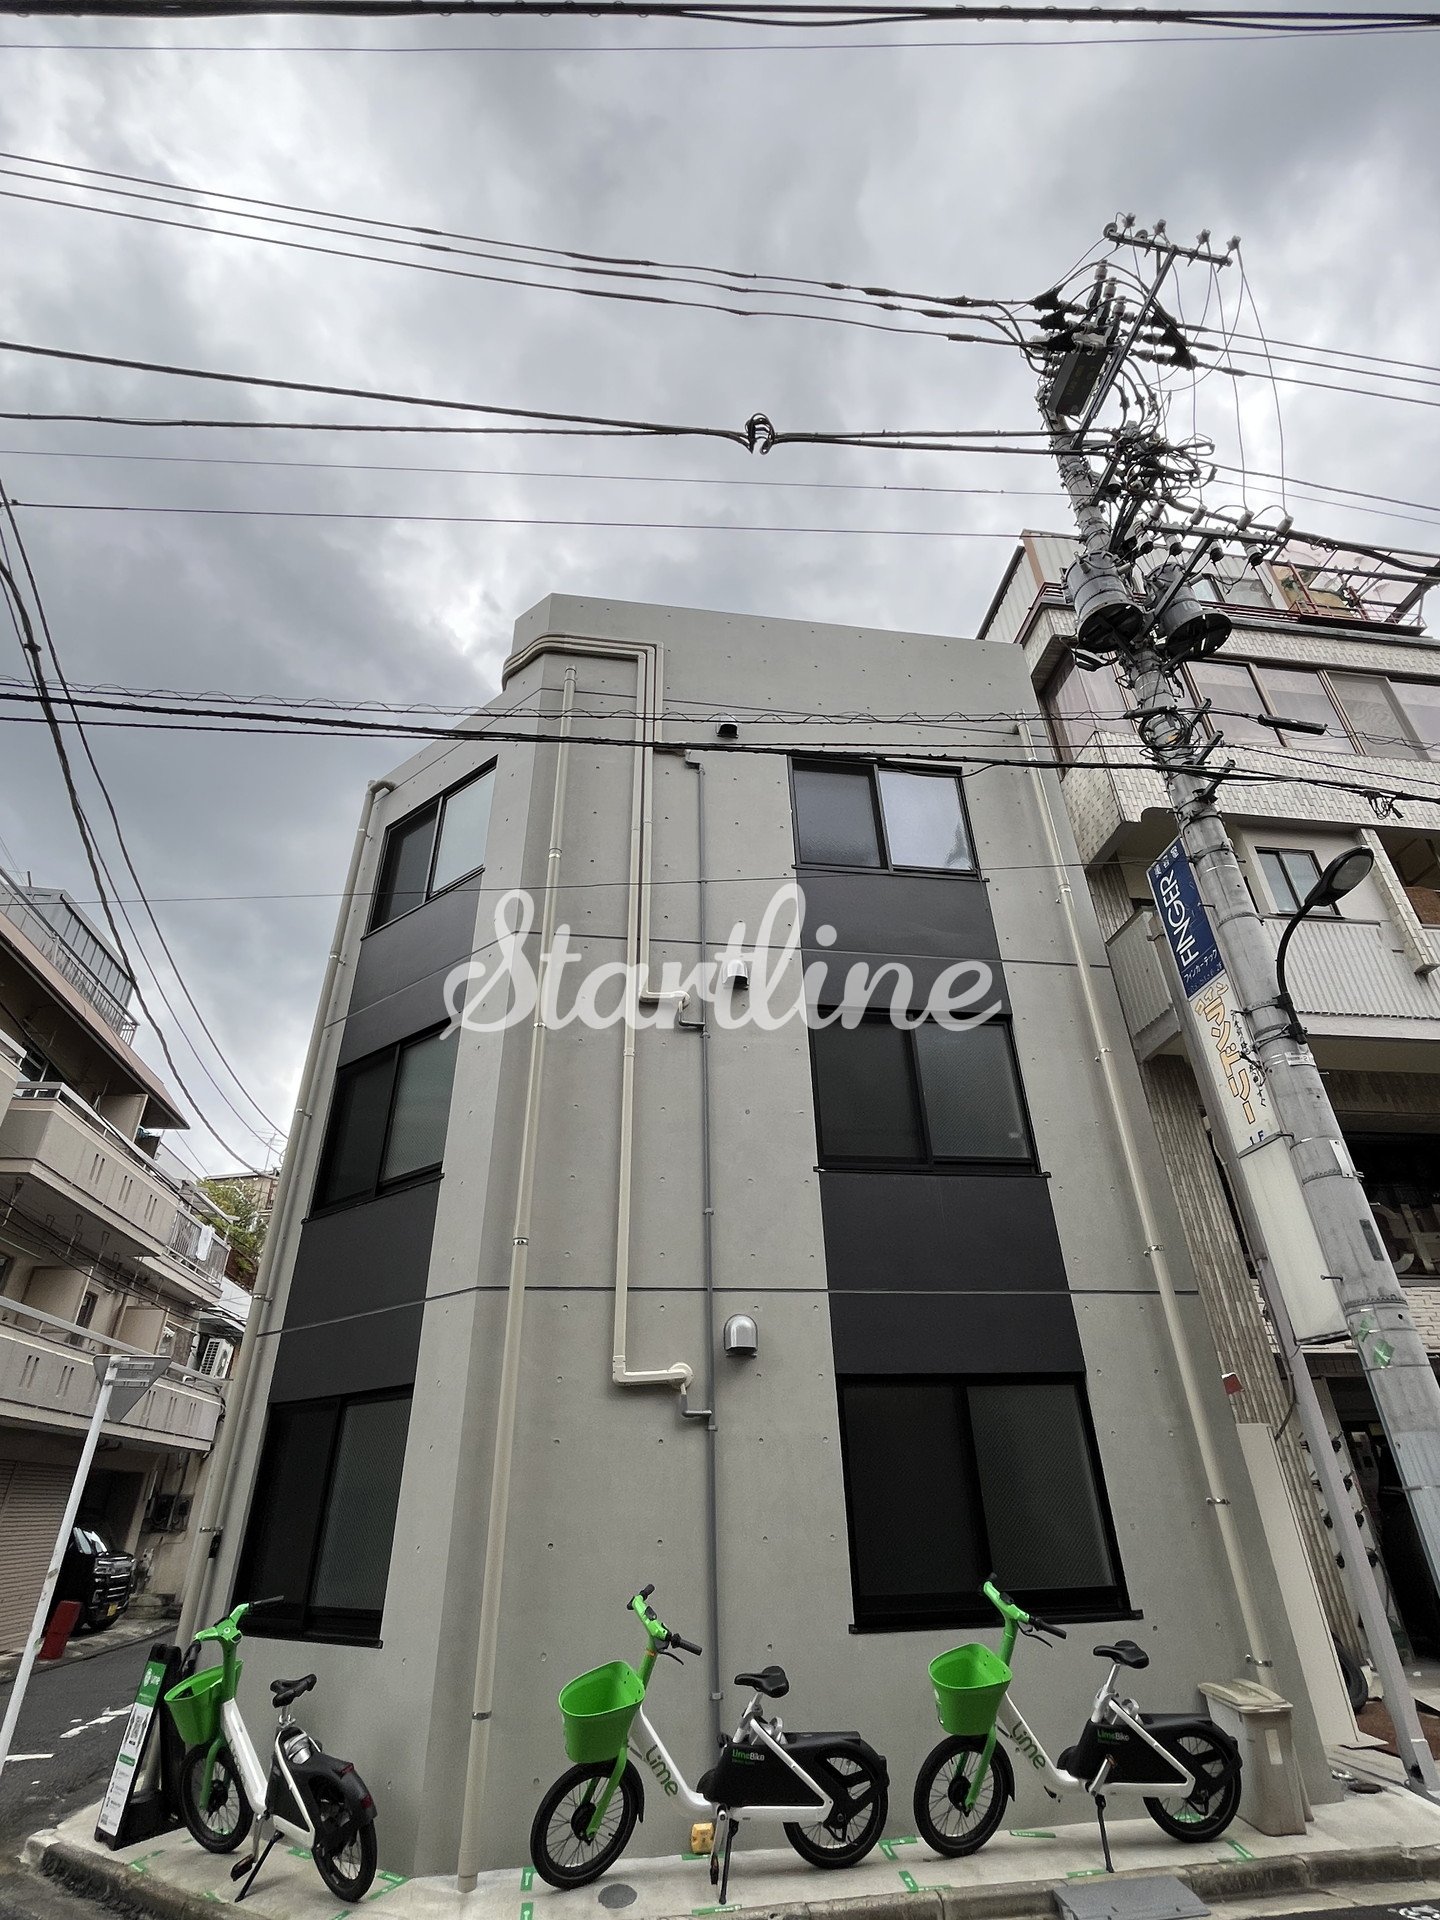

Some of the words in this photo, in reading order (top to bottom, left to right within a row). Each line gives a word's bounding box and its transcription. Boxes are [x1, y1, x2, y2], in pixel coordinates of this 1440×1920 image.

[1159, 869, 1200, 968] FINGER
[1203, 996, 1256, 1125] ランドリー
[645, 1744, 679, 1797] Lime
[1012, 1720, 1046, 1770] Lime
